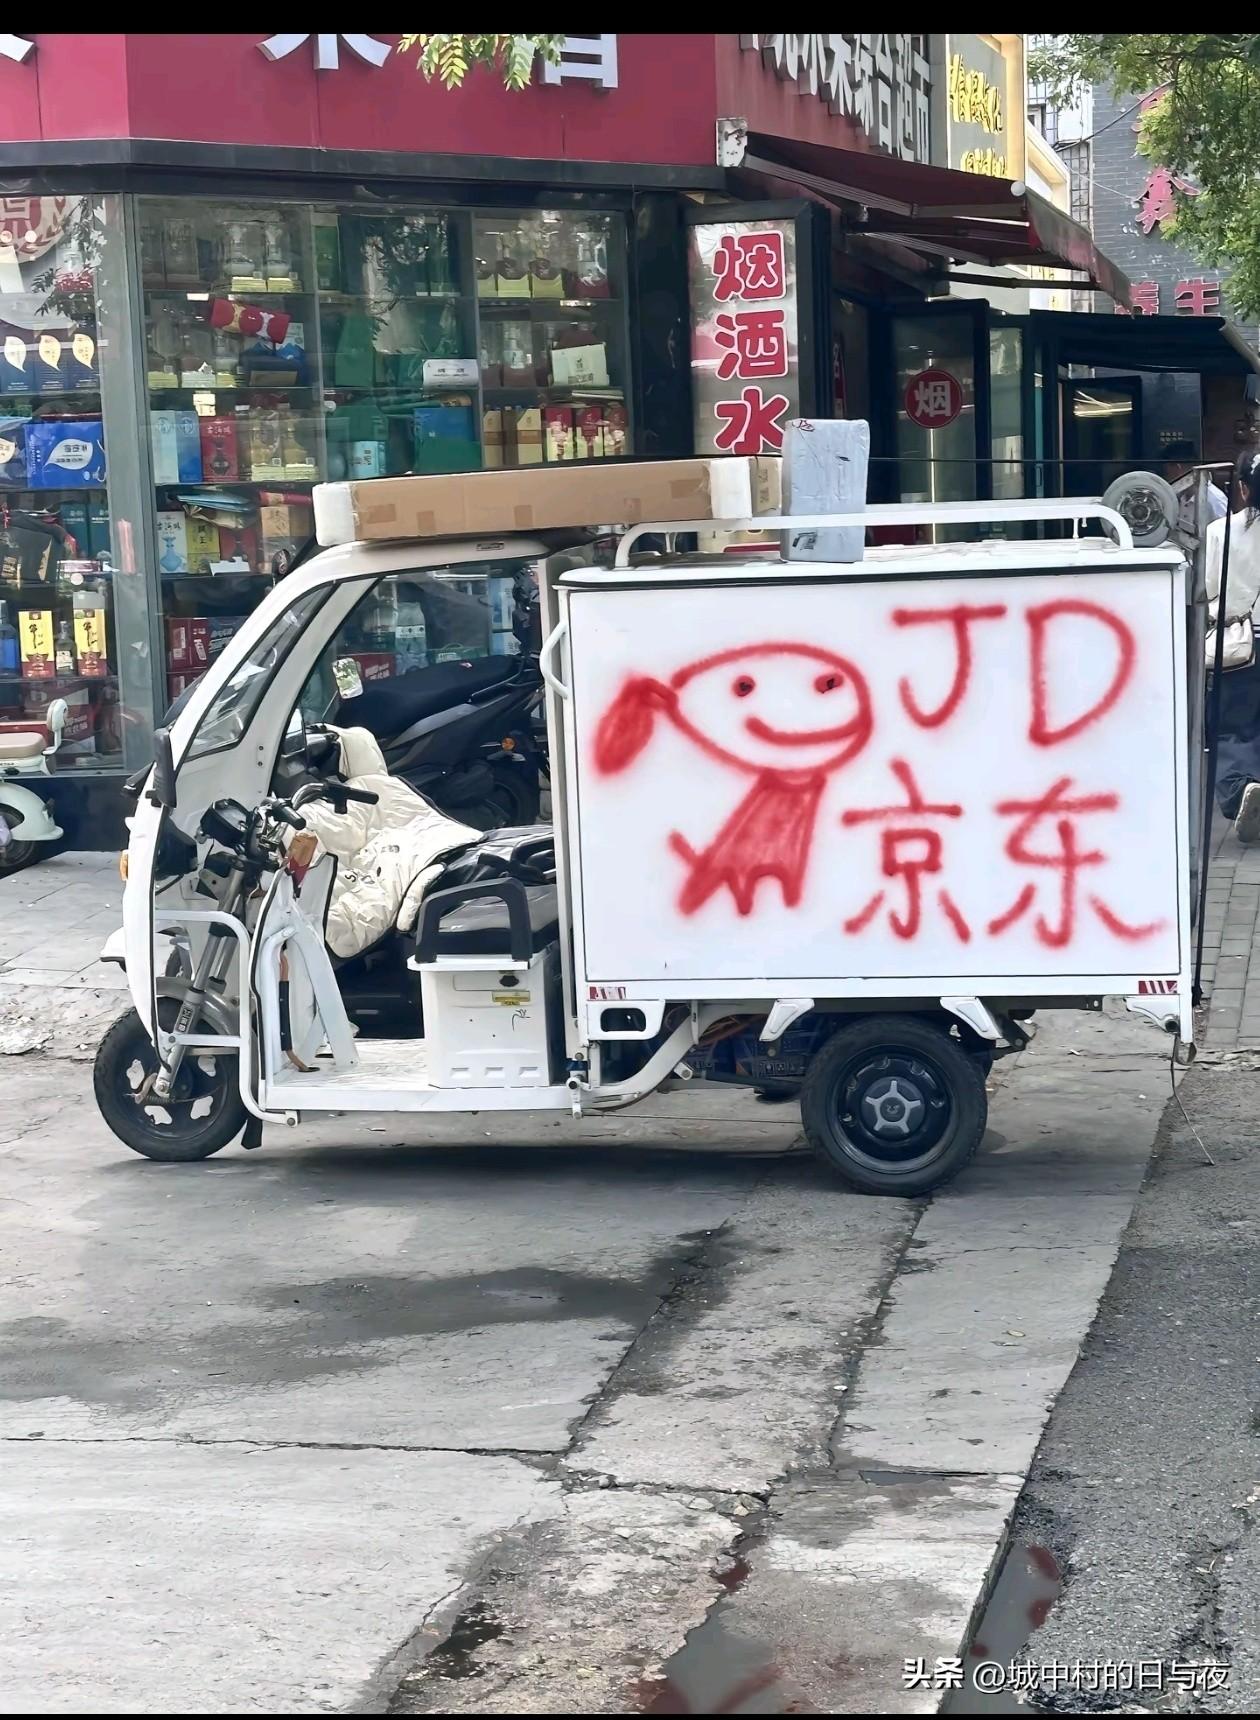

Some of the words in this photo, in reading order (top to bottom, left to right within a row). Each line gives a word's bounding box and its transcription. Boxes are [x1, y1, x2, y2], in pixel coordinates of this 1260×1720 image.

[712, 230, 790, 455] 烟酒水
[914, 380, 952, 417] 烟
[892, 599, 1137, 748] JD
[843, 757, 1168, 950] 京东
